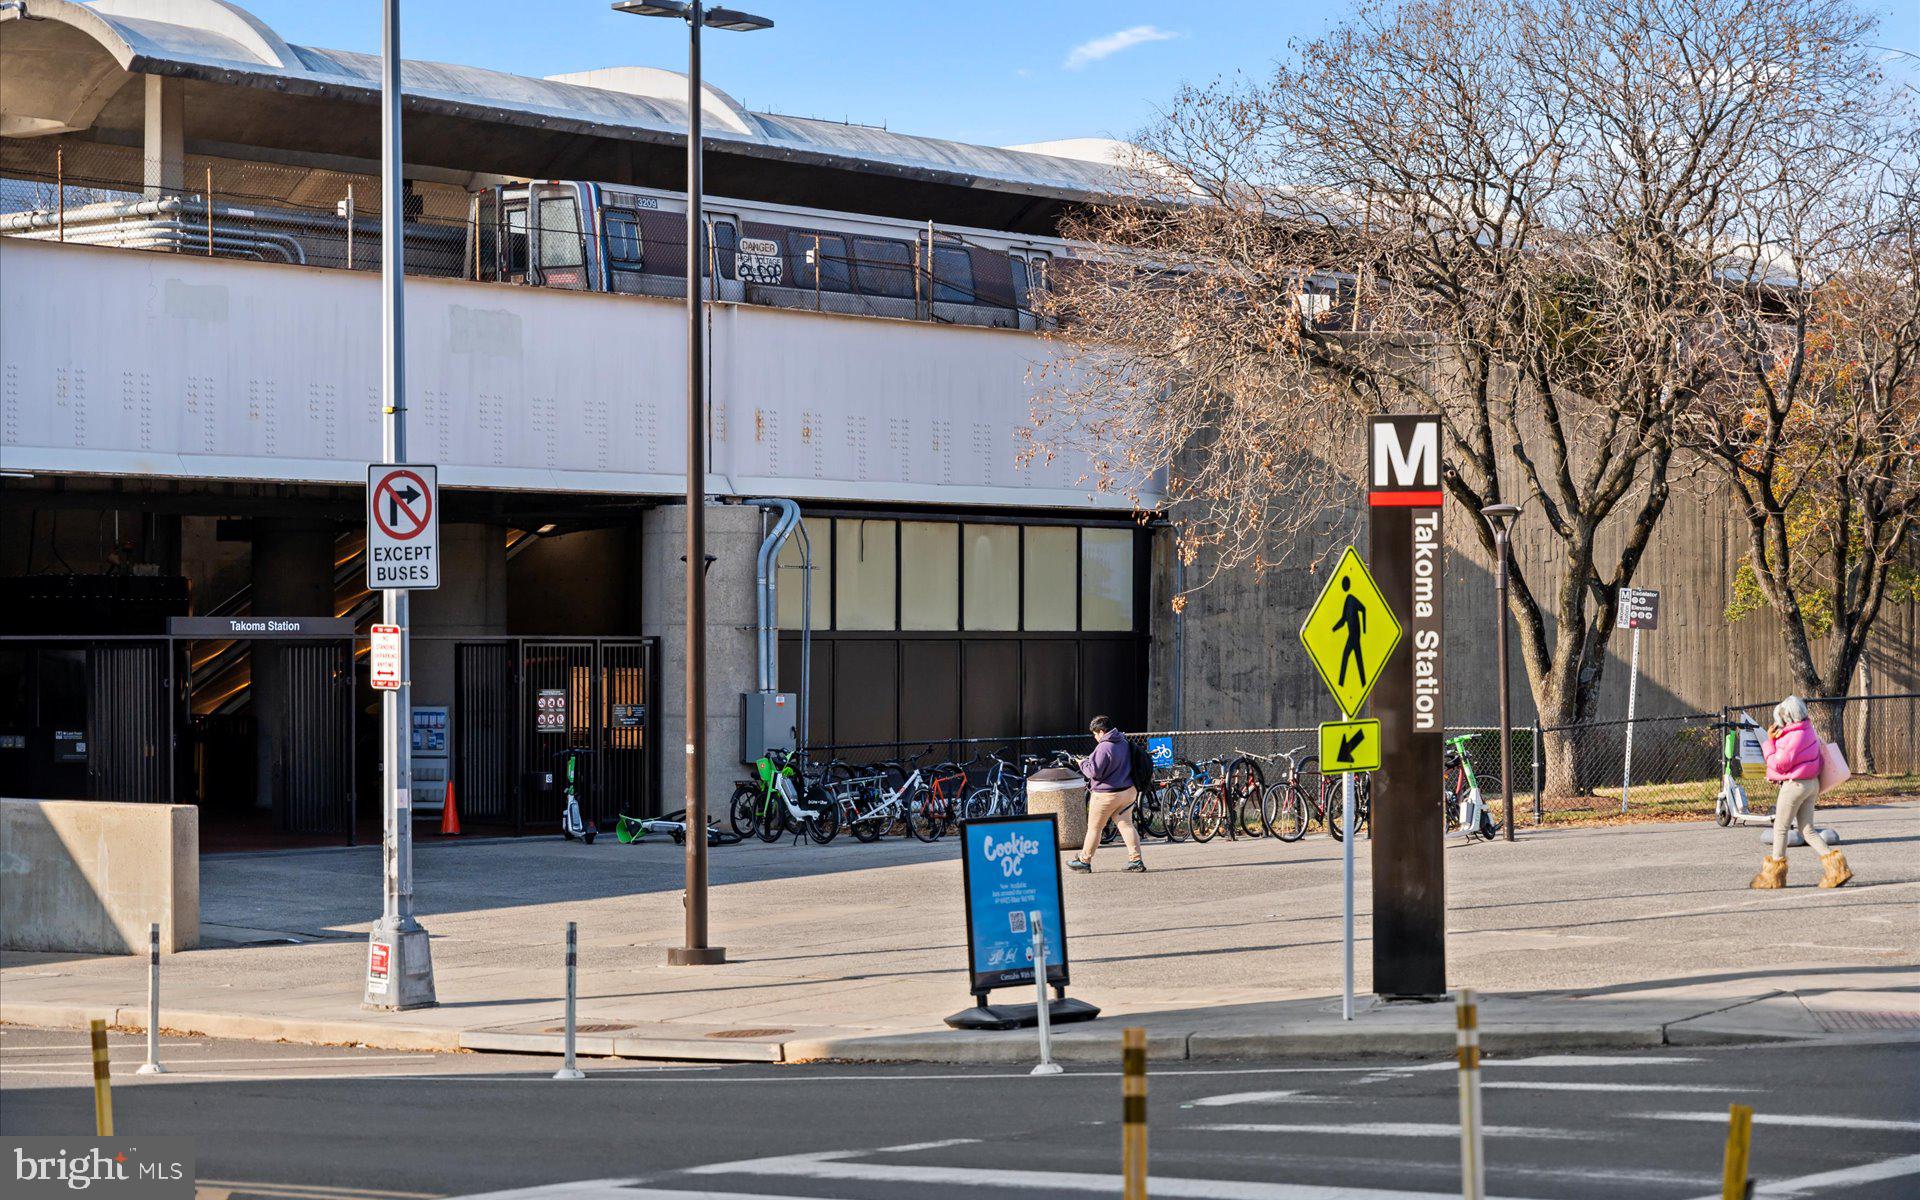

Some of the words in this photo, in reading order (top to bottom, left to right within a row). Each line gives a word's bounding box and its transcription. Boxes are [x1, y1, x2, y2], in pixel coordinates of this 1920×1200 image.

[638, 197, 657, 208] 3209
[742, 240, 776, 253] DANGER
[1374, 422, 1438, 486] M
[374, 546, 432, 562] EXCEPT
[377, 565, 429, 581] BUSES
[1415, 512, 1438, 618] Takoma
[229, 620, 266, 631] Takoma
[268, 620, 300, 631] Station
[1415, 630, 1439, 728] Station
[984, 832, 1040, 861] Cookies
[1001, 856, 1023, 877] DC
